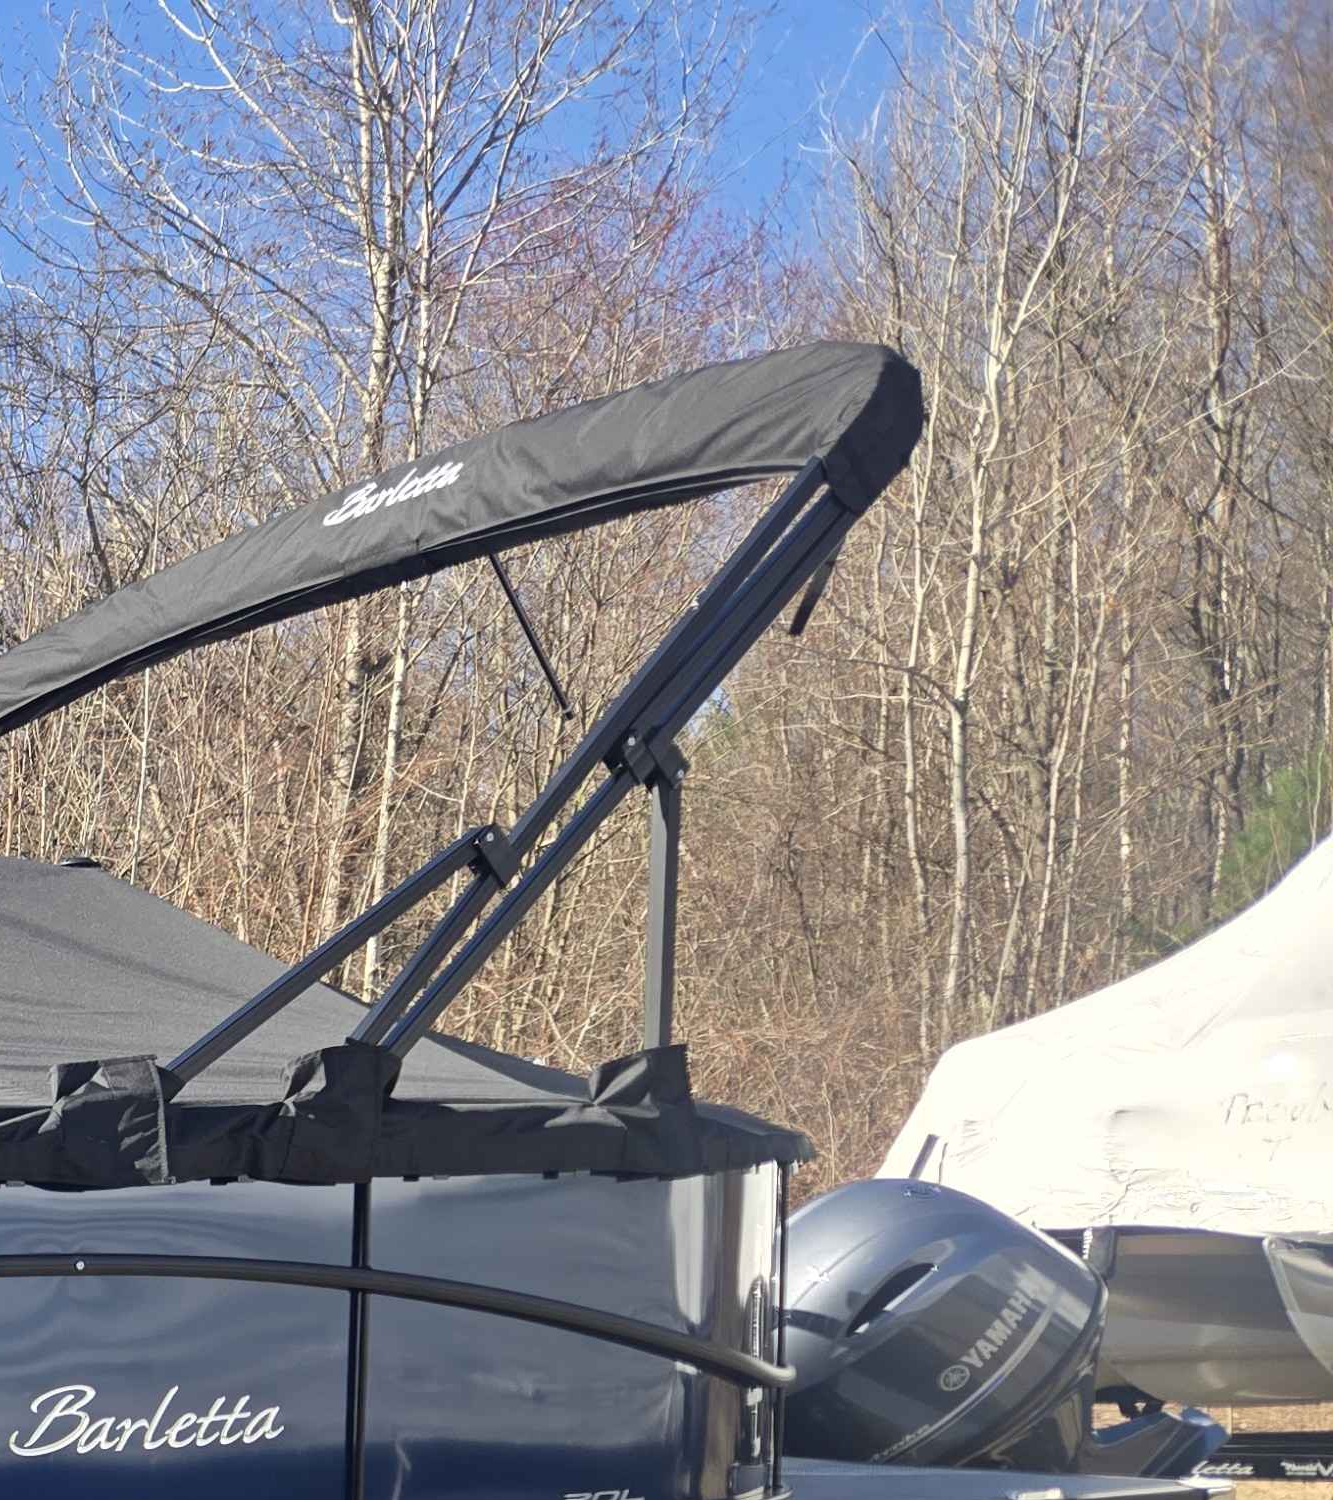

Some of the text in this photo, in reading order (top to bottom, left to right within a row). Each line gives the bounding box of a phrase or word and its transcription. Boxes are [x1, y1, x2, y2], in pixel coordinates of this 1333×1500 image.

[323, 462, 463, 526] Barletta
[9, 1385, 284, 1456] Barletta
[1190, 1460, 1254, 1475] letta
